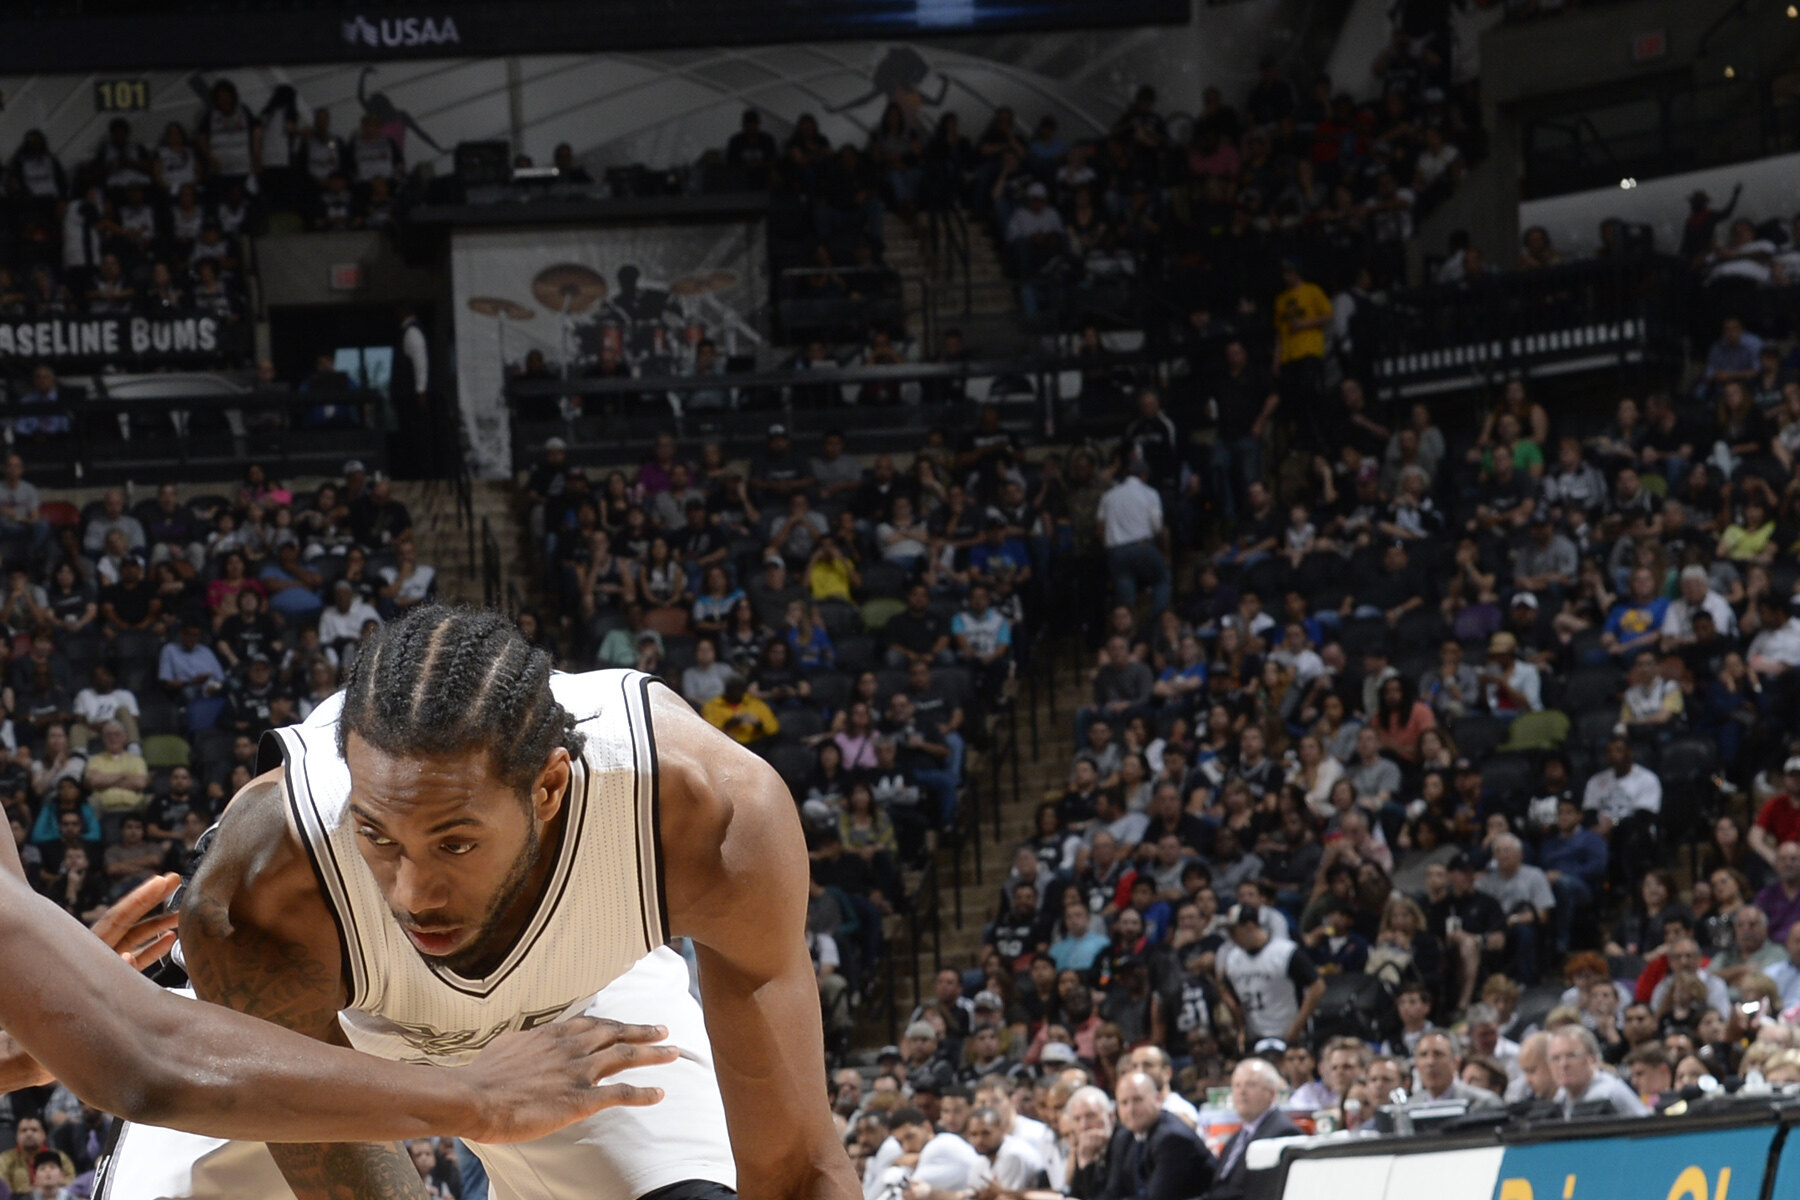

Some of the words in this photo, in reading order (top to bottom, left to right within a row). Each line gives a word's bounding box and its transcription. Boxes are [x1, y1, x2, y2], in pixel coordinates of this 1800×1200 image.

[380, 15, 462, 47] USAA
[98, 82, 145, 109] 101
[130, 316, 218, 353] BUMS
